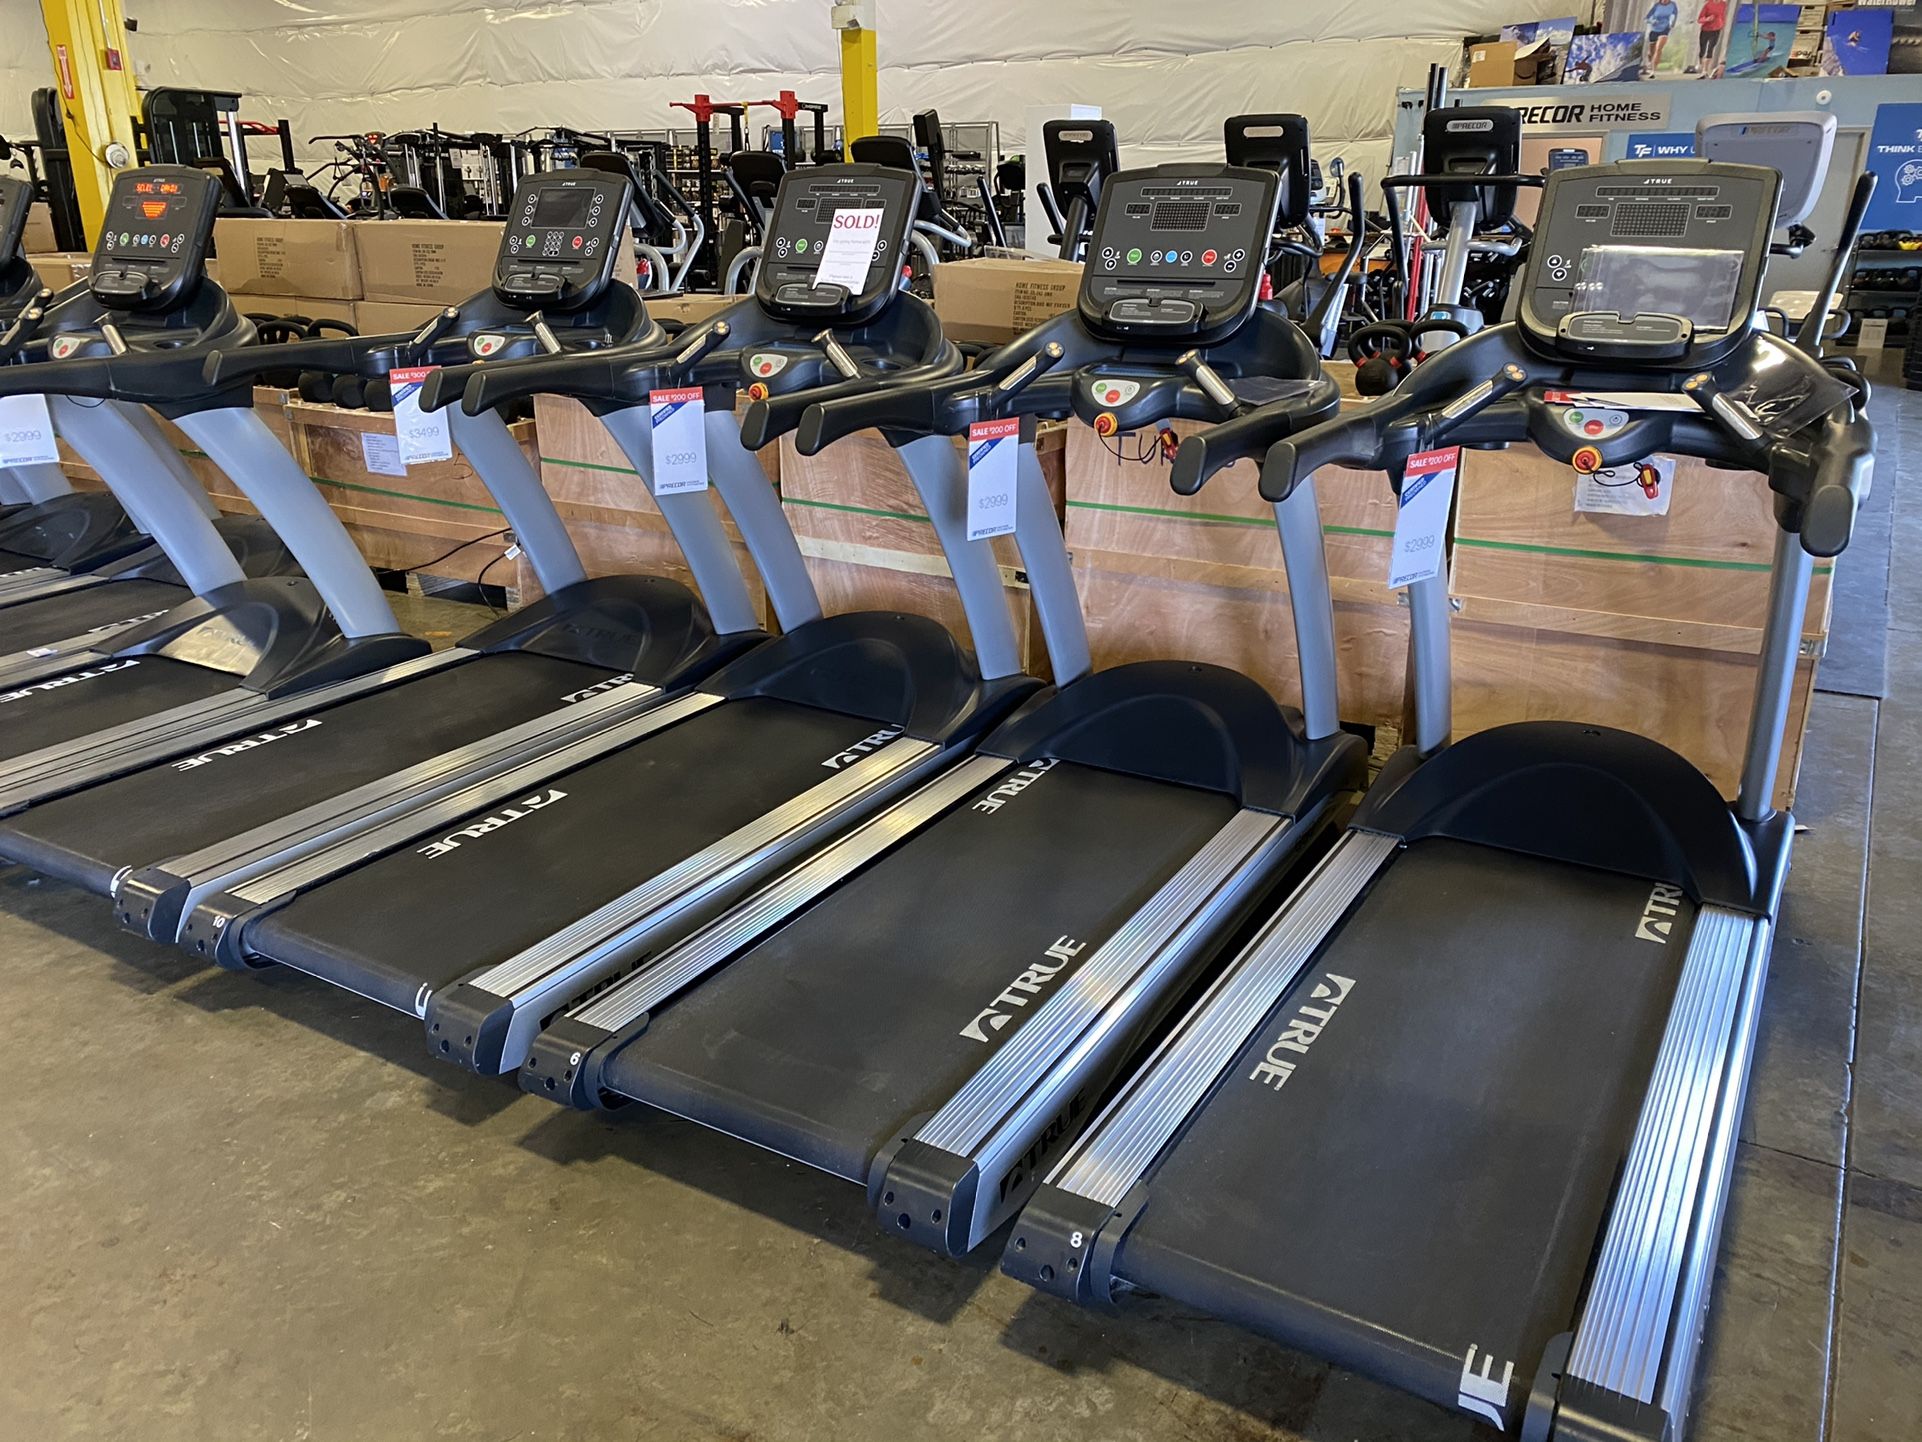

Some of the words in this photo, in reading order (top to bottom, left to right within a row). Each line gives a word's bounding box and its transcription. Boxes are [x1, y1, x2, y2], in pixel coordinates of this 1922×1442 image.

[1517, 105, 1586, 125] RECOR
[1590, 102, 1642, 113] HOME
[1588, 112, 1661, 122] FITNESS
[1657, 145, 1688, 154] WHY
[1877, 145, 1916, 153] THINK
[833, 214, 881, 229] SOLD!
[392, 372, 410, 380] SALE
[652, 394, 670, 402] SALE
[670, 393, 687, 401] $200
[687, 392, 700, 400] OFF
[4, 430, 42, 442] $2999
[408, 426, 440, 440] $3499
[971, 427, 989, 437] SALE
[989, 425, 1003, 435] $200
[1004, 423, 1016, 432] OFF
[665, 451, 697, 466] $2999
[1410, 457, 1428, 469] SALE
[1428, 455, 1443, 466] $200
[1443, 452, 1456, 463] OFF
[979, 493, 1009, 509] $2999
[1404, 534, 1435, 553] $2999
[588, 673, 635, 690] TR
[845, 723, 905, 752] TRU
[171, 732, 288, 772] TRUE
[971, 770, 1046, 815] TRUE
[416, 808, 535, 860] TRUE
[1643, 882, 1684, 917] TR
[212, 915, 226, 929] 10
[989, 934, 1087, 1008] TRUE
[1249, 1005, 1338, 1092] TRUE
[569, 1051, 581, 1066] 6
[1023, 1087, 1088, 1171] TRUE
[1070, 1231, 1083, 1248] 8
